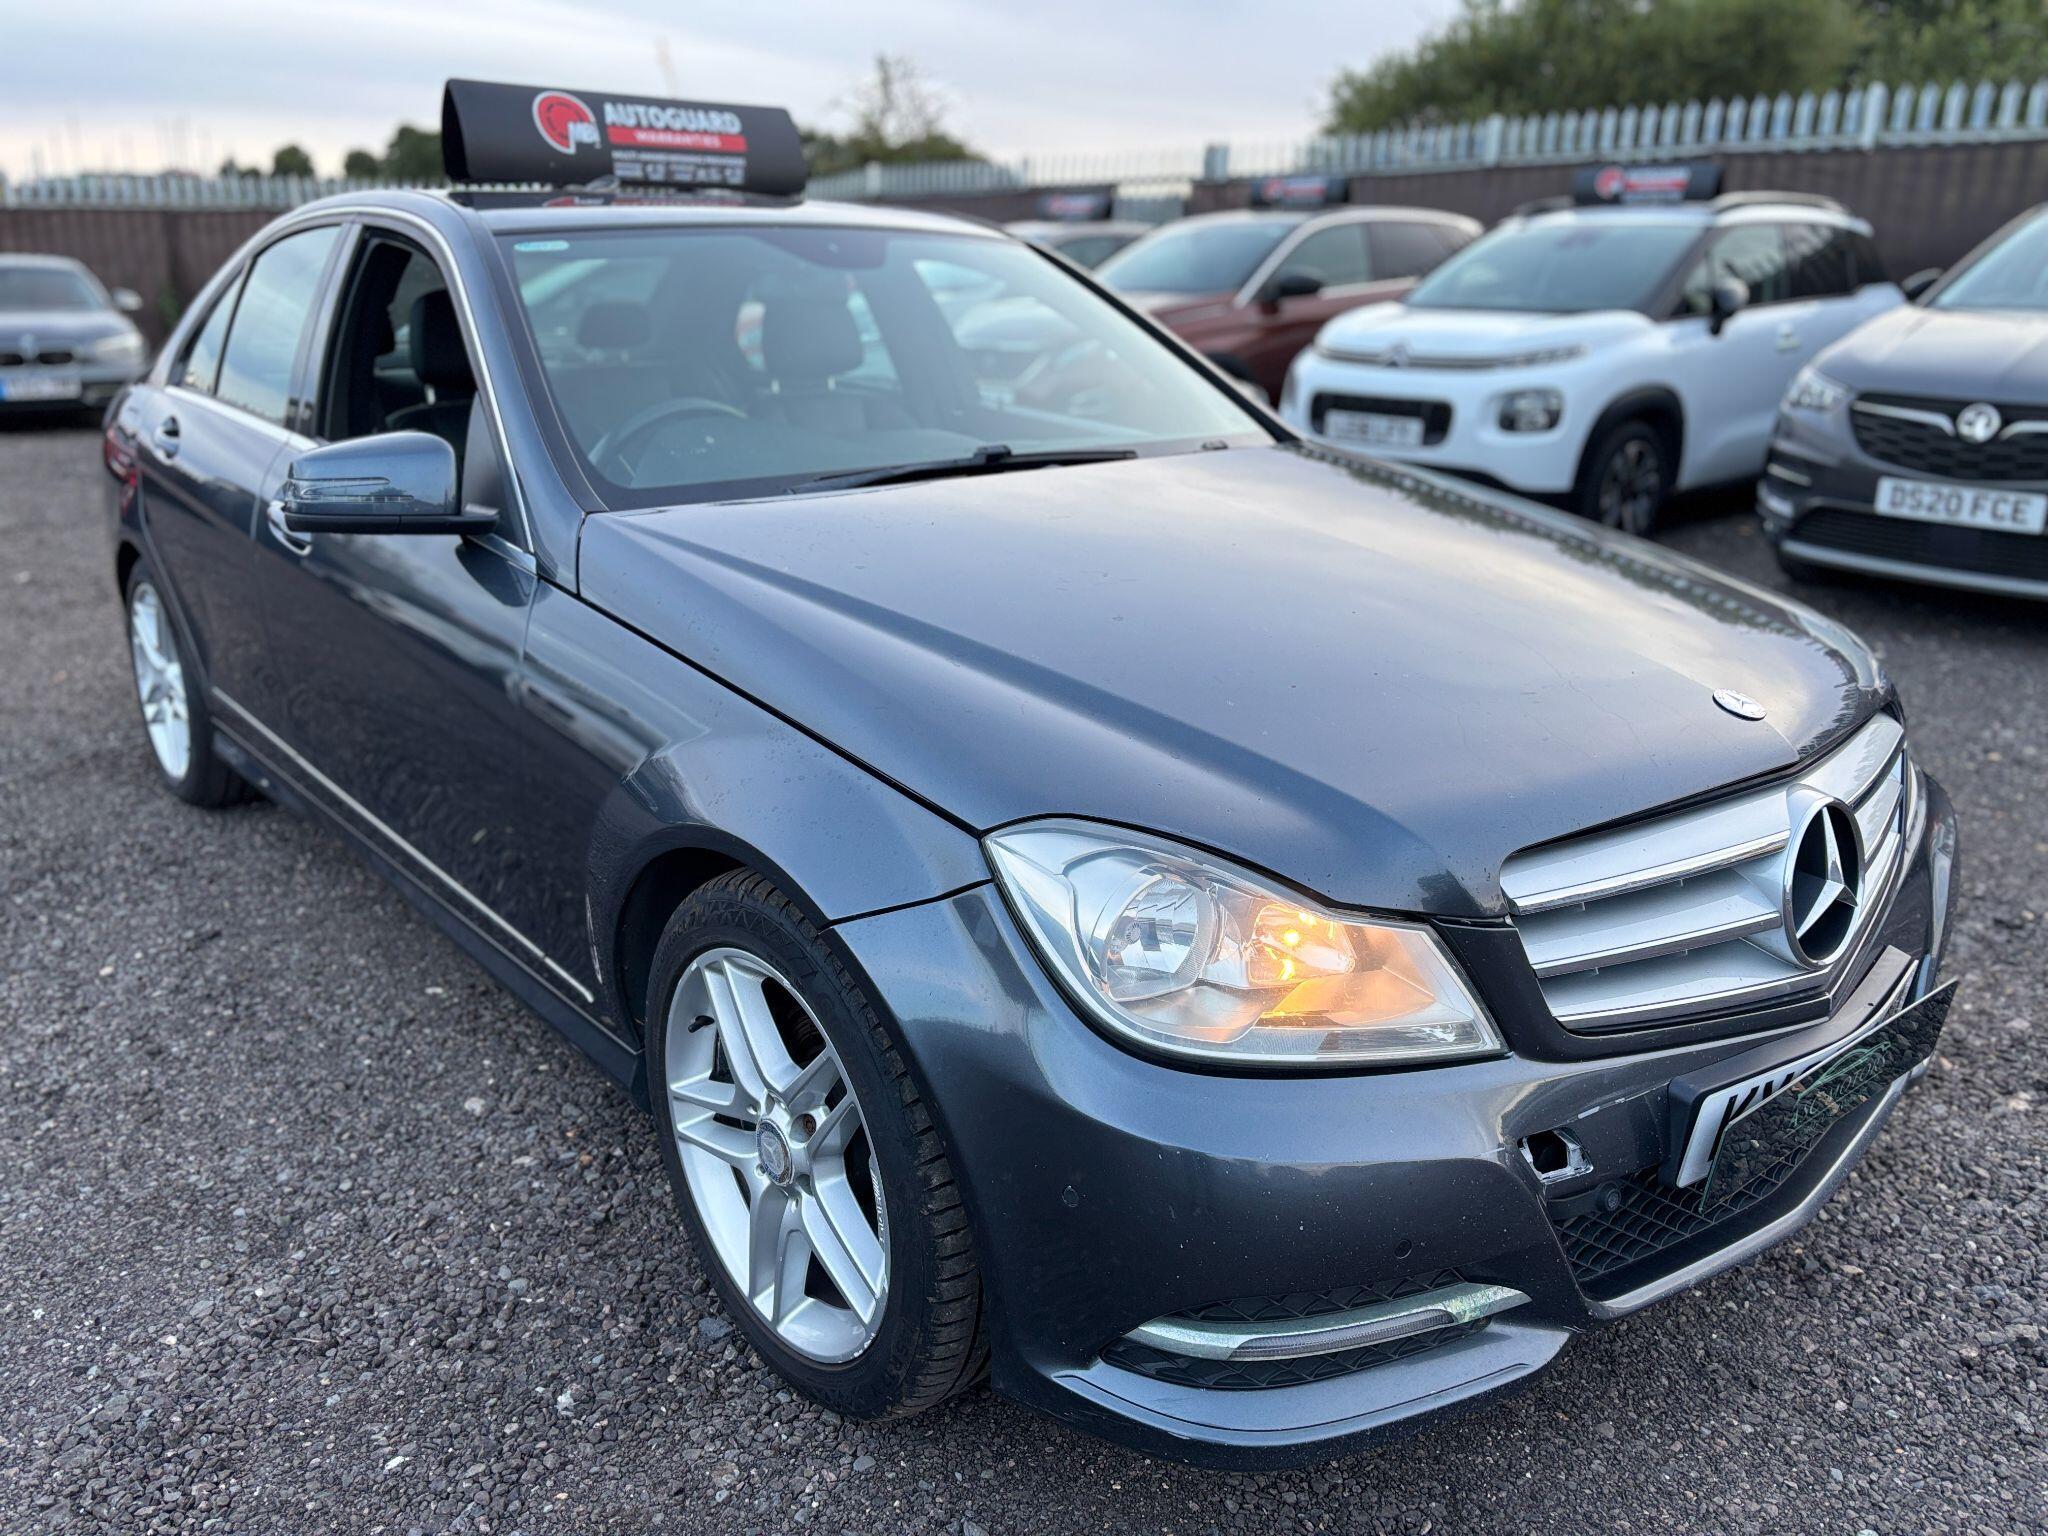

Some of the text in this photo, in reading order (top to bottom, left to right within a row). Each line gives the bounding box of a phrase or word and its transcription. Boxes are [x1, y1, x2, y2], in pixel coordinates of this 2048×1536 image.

[603, 102, 743, 135] AUTOGUARD
[1890, 485, 2031, 525] DS20 FCE
